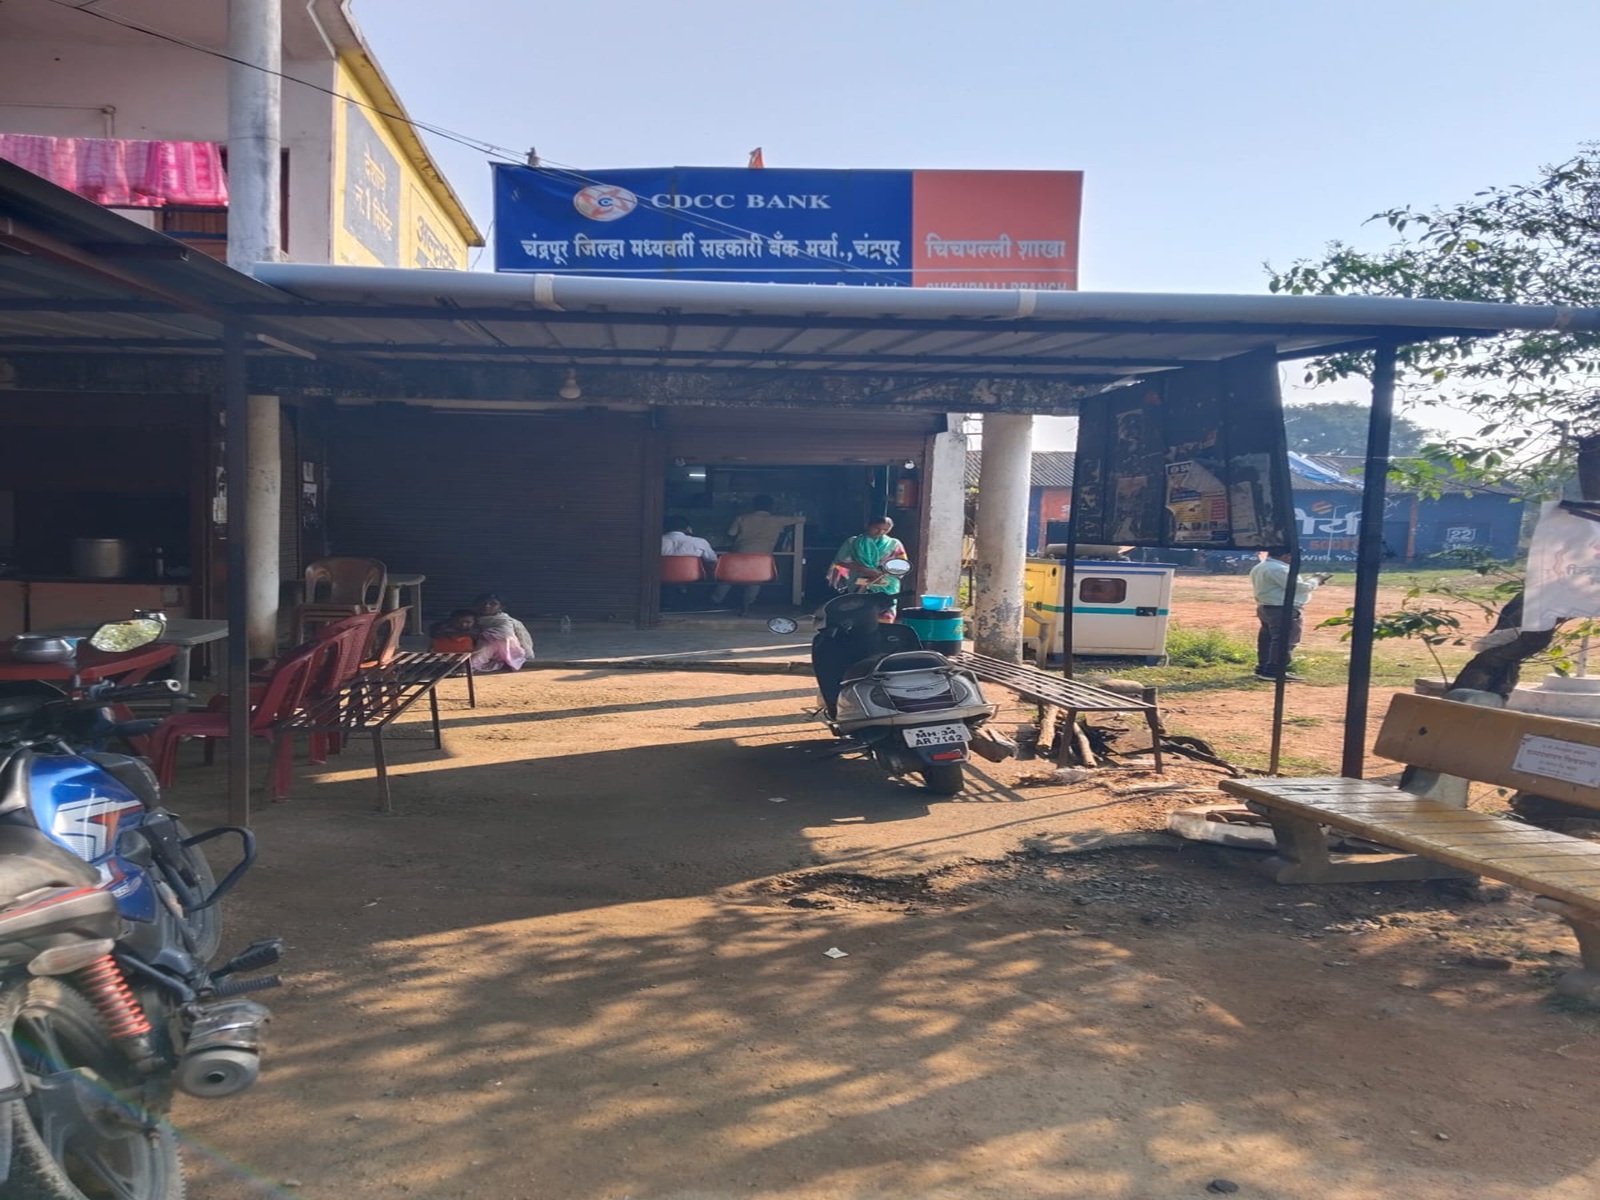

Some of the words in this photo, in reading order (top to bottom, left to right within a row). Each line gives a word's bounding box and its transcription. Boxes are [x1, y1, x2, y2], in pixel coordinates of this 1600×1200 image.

[651, 193, 735, 209] CDCC
[747, 193, 831, 209] BANK
[520, 232, 569, 265] चंद्रपूर
[573, 232, 625, 260] जिल्हा
[629, 231, 695, 258] मध्यवर्ती
[699, 232, 763, 259] सहकारी
[1017, 240, 1066, 260] शाखा
